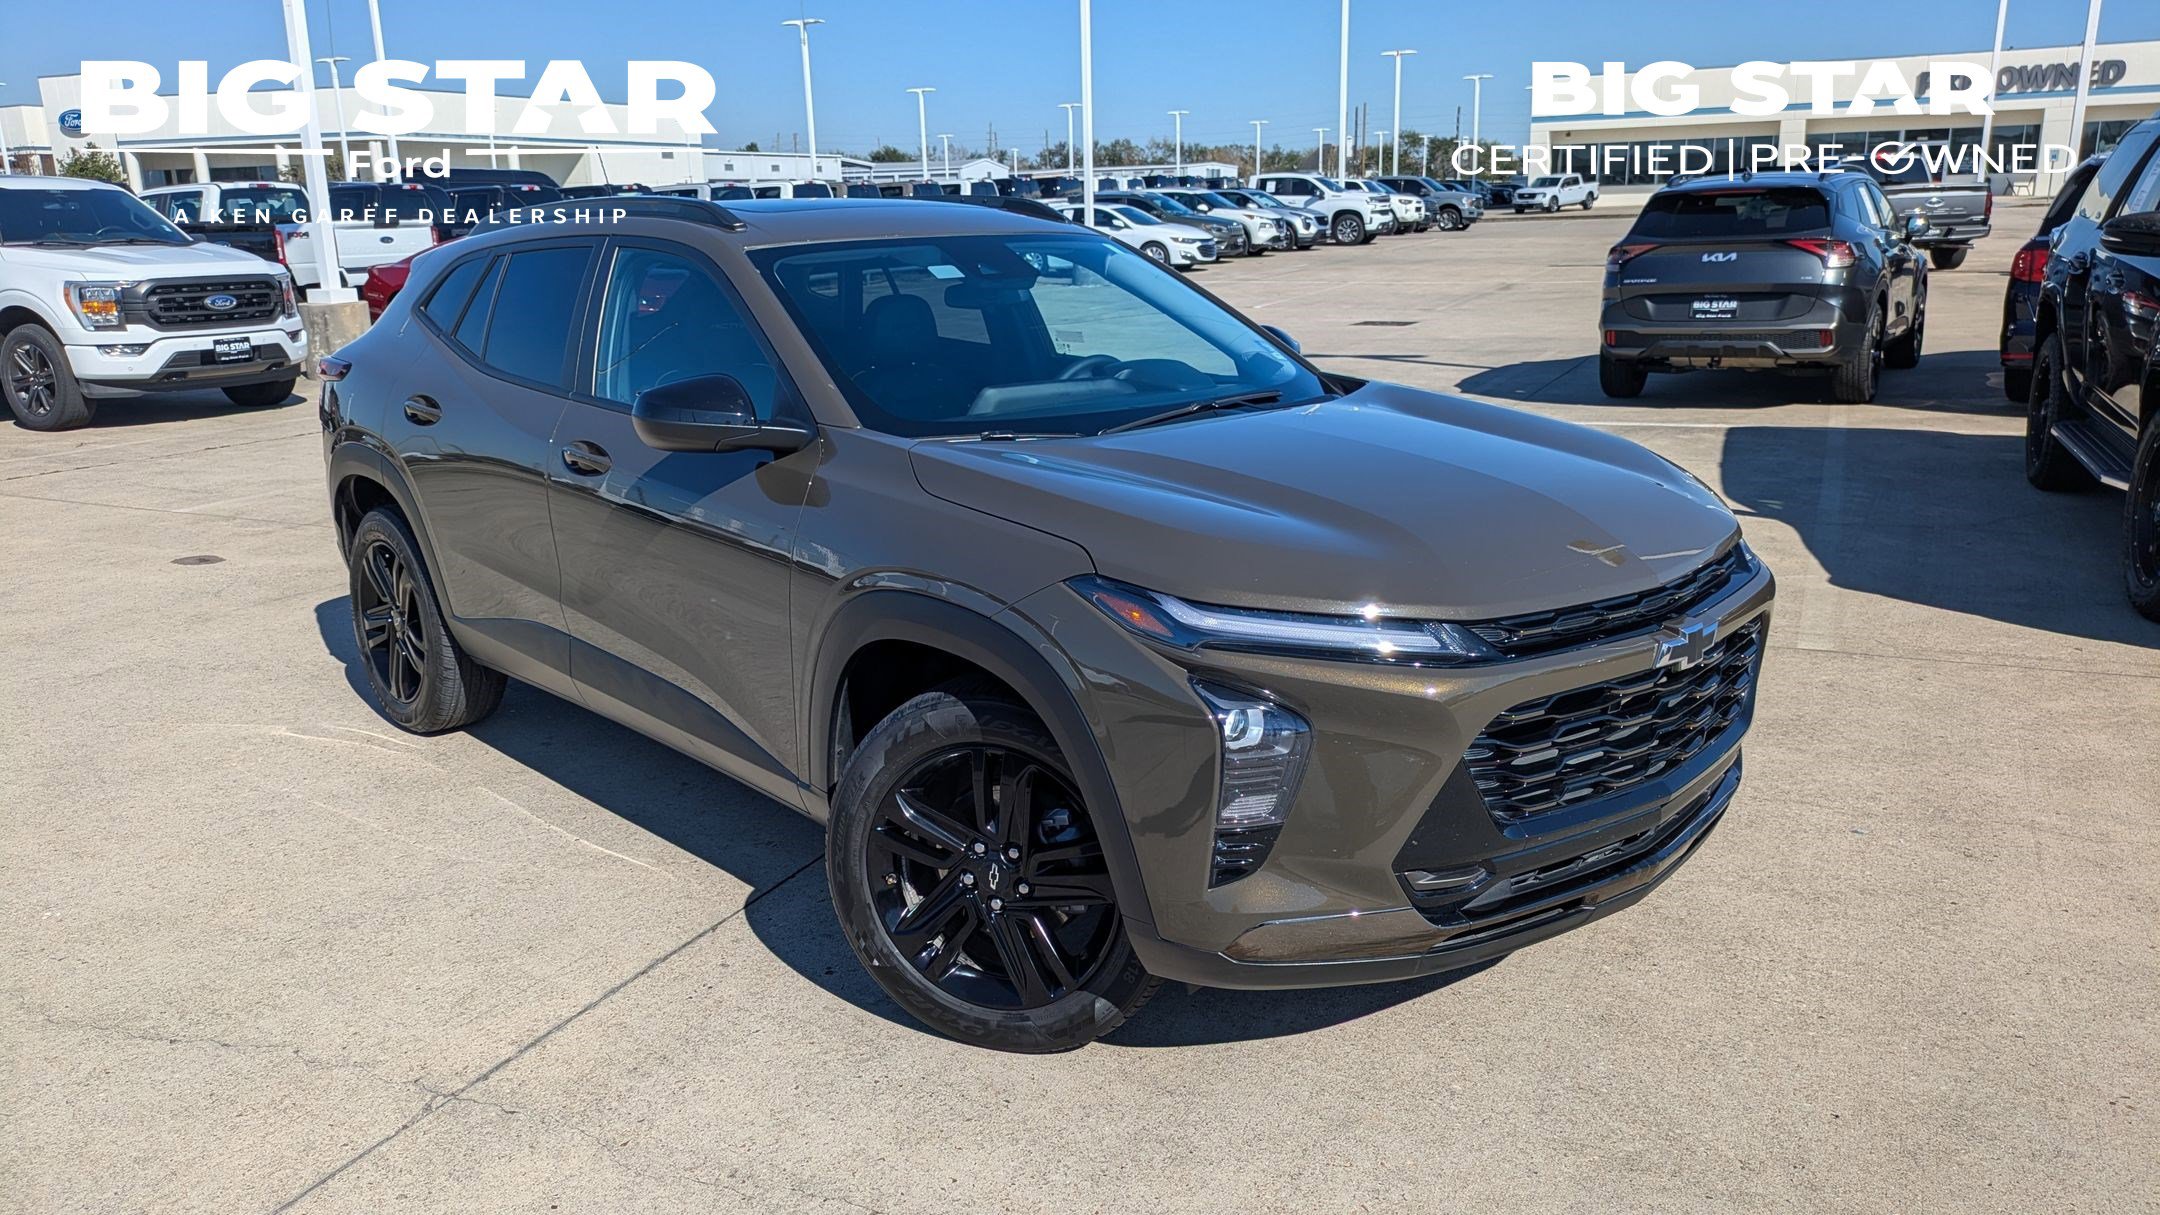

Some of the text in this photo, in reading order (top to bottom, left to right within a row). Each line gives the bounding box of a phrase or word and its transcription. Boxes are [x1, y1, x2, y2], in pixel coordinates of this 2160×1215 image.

[1693, 300, 1738, 309] BIG STAR
[215, 341, 250, 352] BIG STAR
